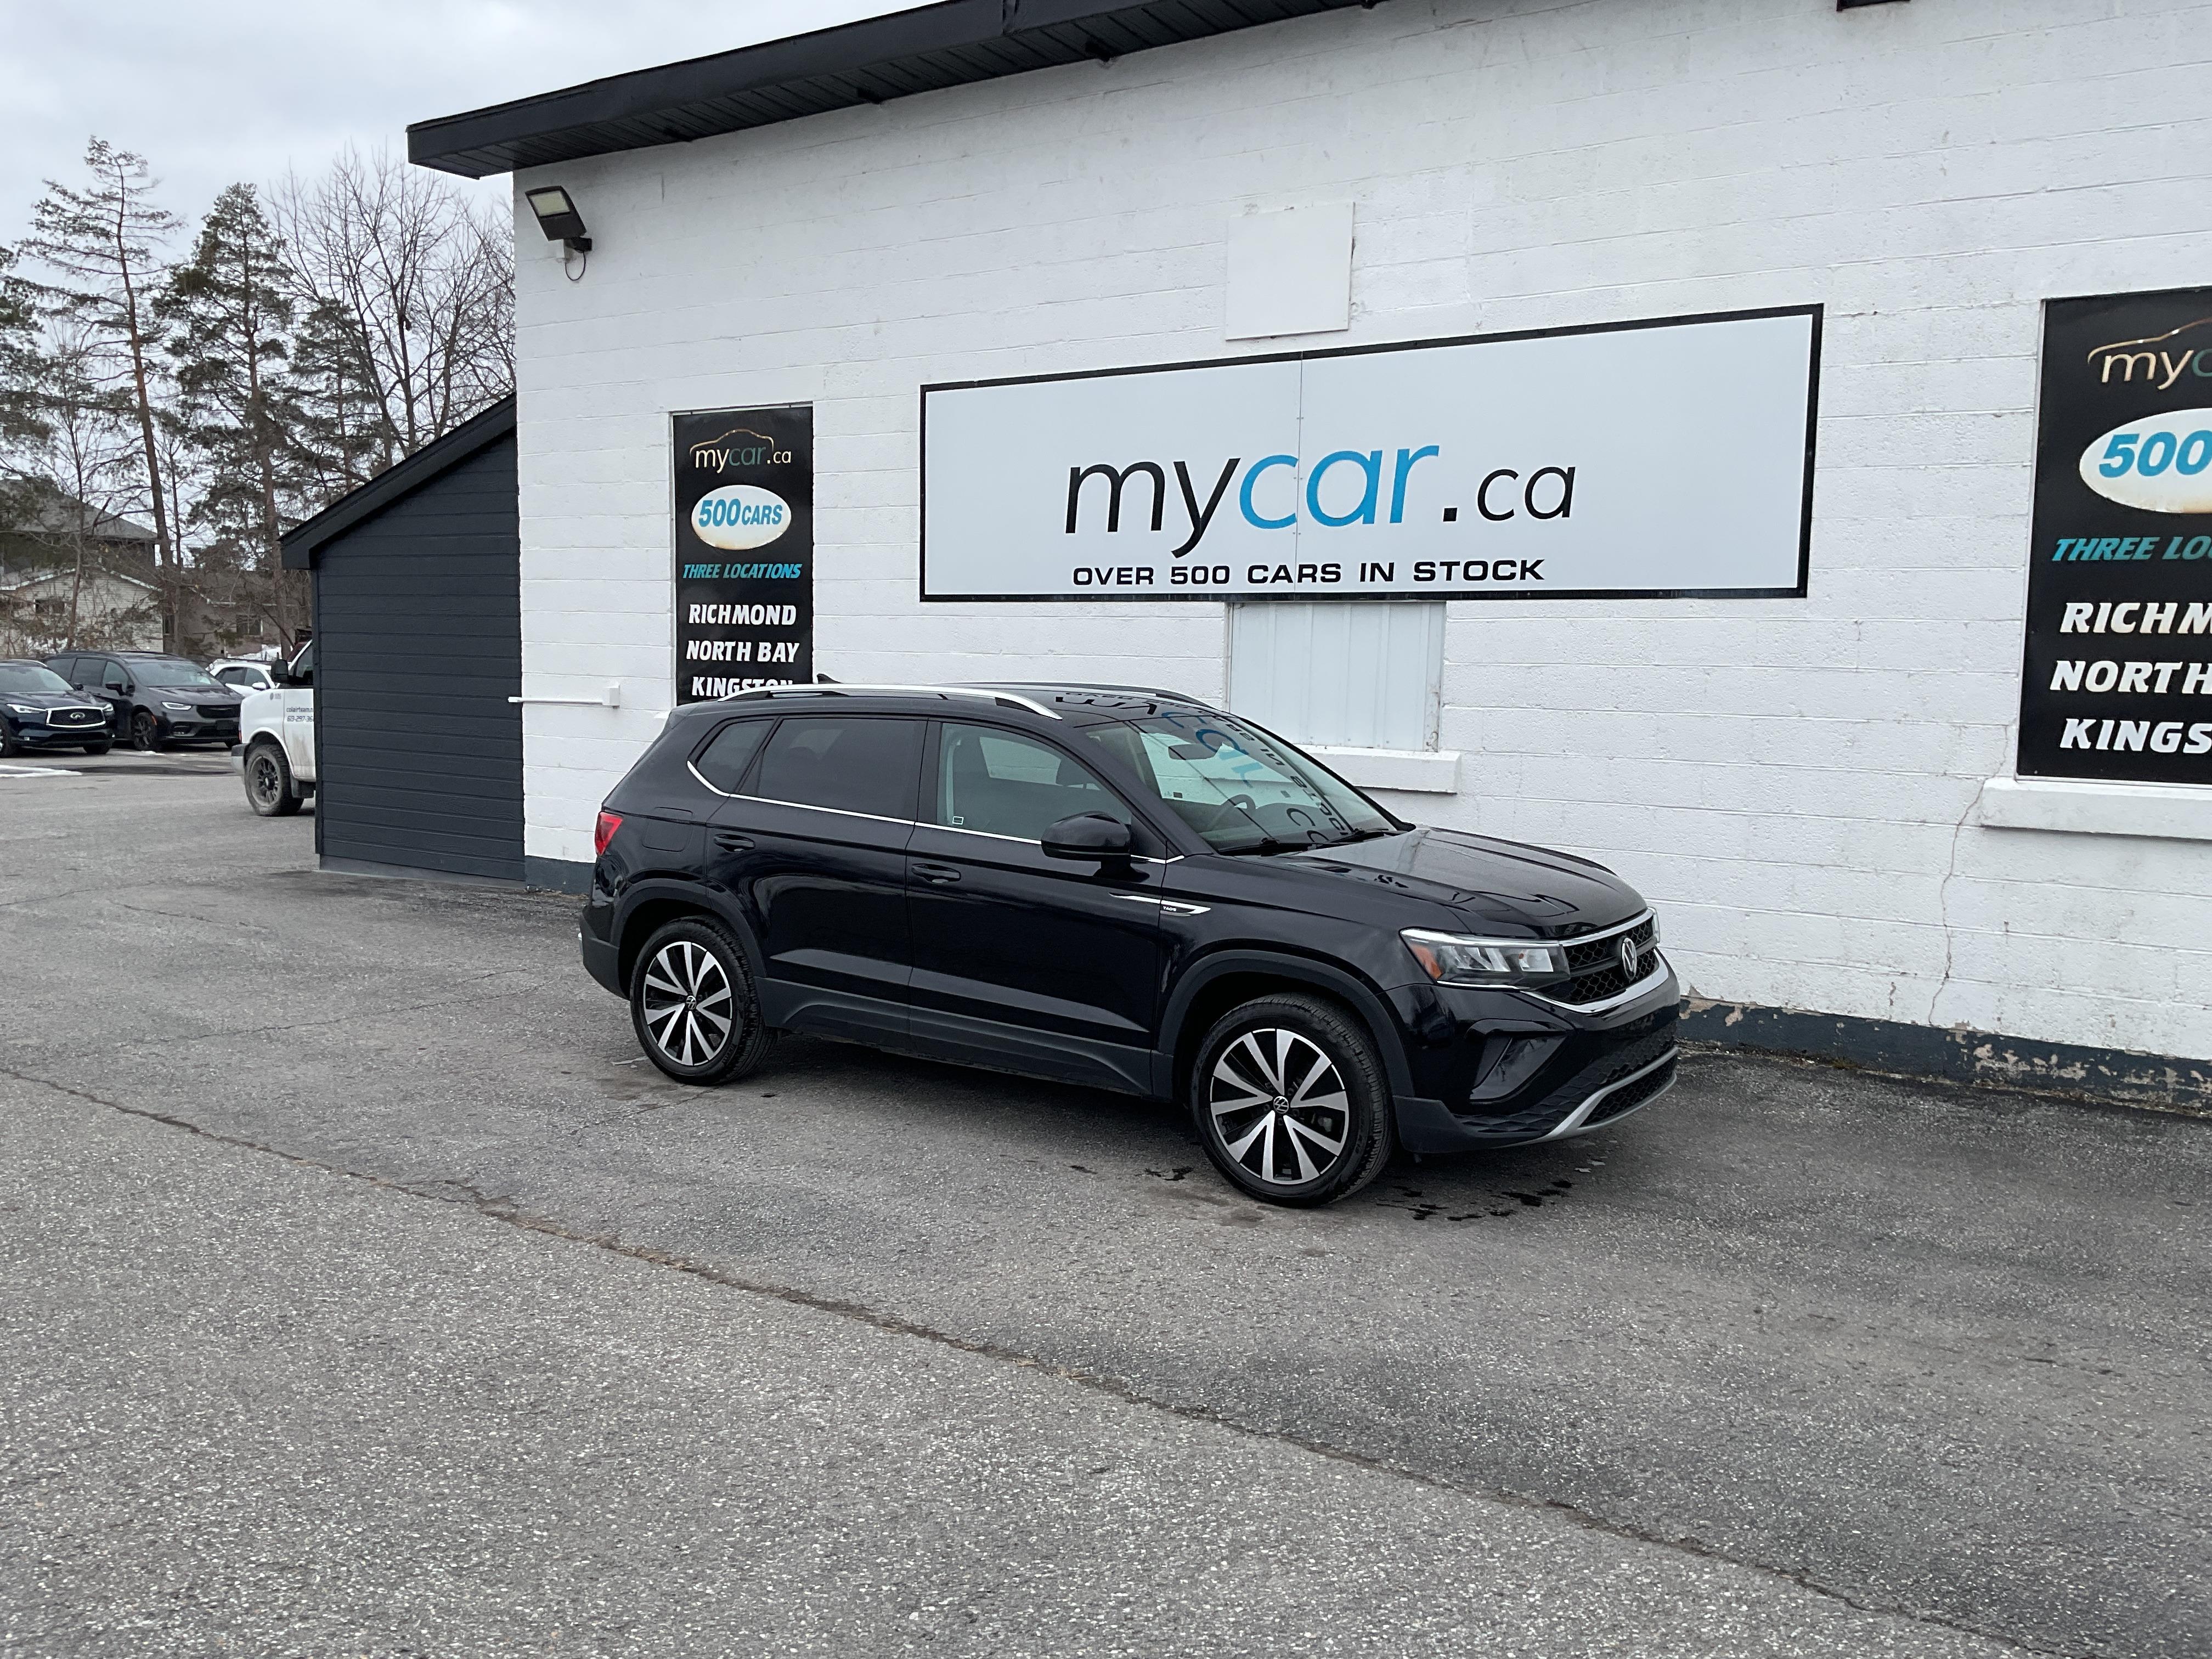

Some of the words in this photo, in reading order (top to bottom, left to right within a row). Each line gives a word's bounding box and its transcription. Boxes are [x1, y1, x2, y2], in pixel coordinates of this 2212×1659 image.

[695, 447, 792, 473] mycar.ca
[2099, 430, 2212, 478] 500
[698, 499, 741, 527] 500
[742, 504, 783, 525] CARS
[1065, 445, 1576, 559] mycar.ca
[2052, 537, 2160, 561] THREE
[2162, 535, 2212, 560] LO
[682, 563, 722, 579] THREE
[723, 563, 803, 579] LOCATIONS
[1073, 567, 1154, 585] OVER
[1170, 565, 1231, 584] 500
[1247, 563, 1342, 584] CARS
[1359, 561, 1395, 583] IN
[1413, 559, 1545, 582] STOCK
[689, 604, 797, 625] RICHMOND
[686, 640, 752, 662] NORTH
[757, 641, 800, 663] BAY
[691, 676, 794, 697] KINGS
[2049, 660, 2212, 694] NORTH
[2059, 718, 2212, 754] KINGS
